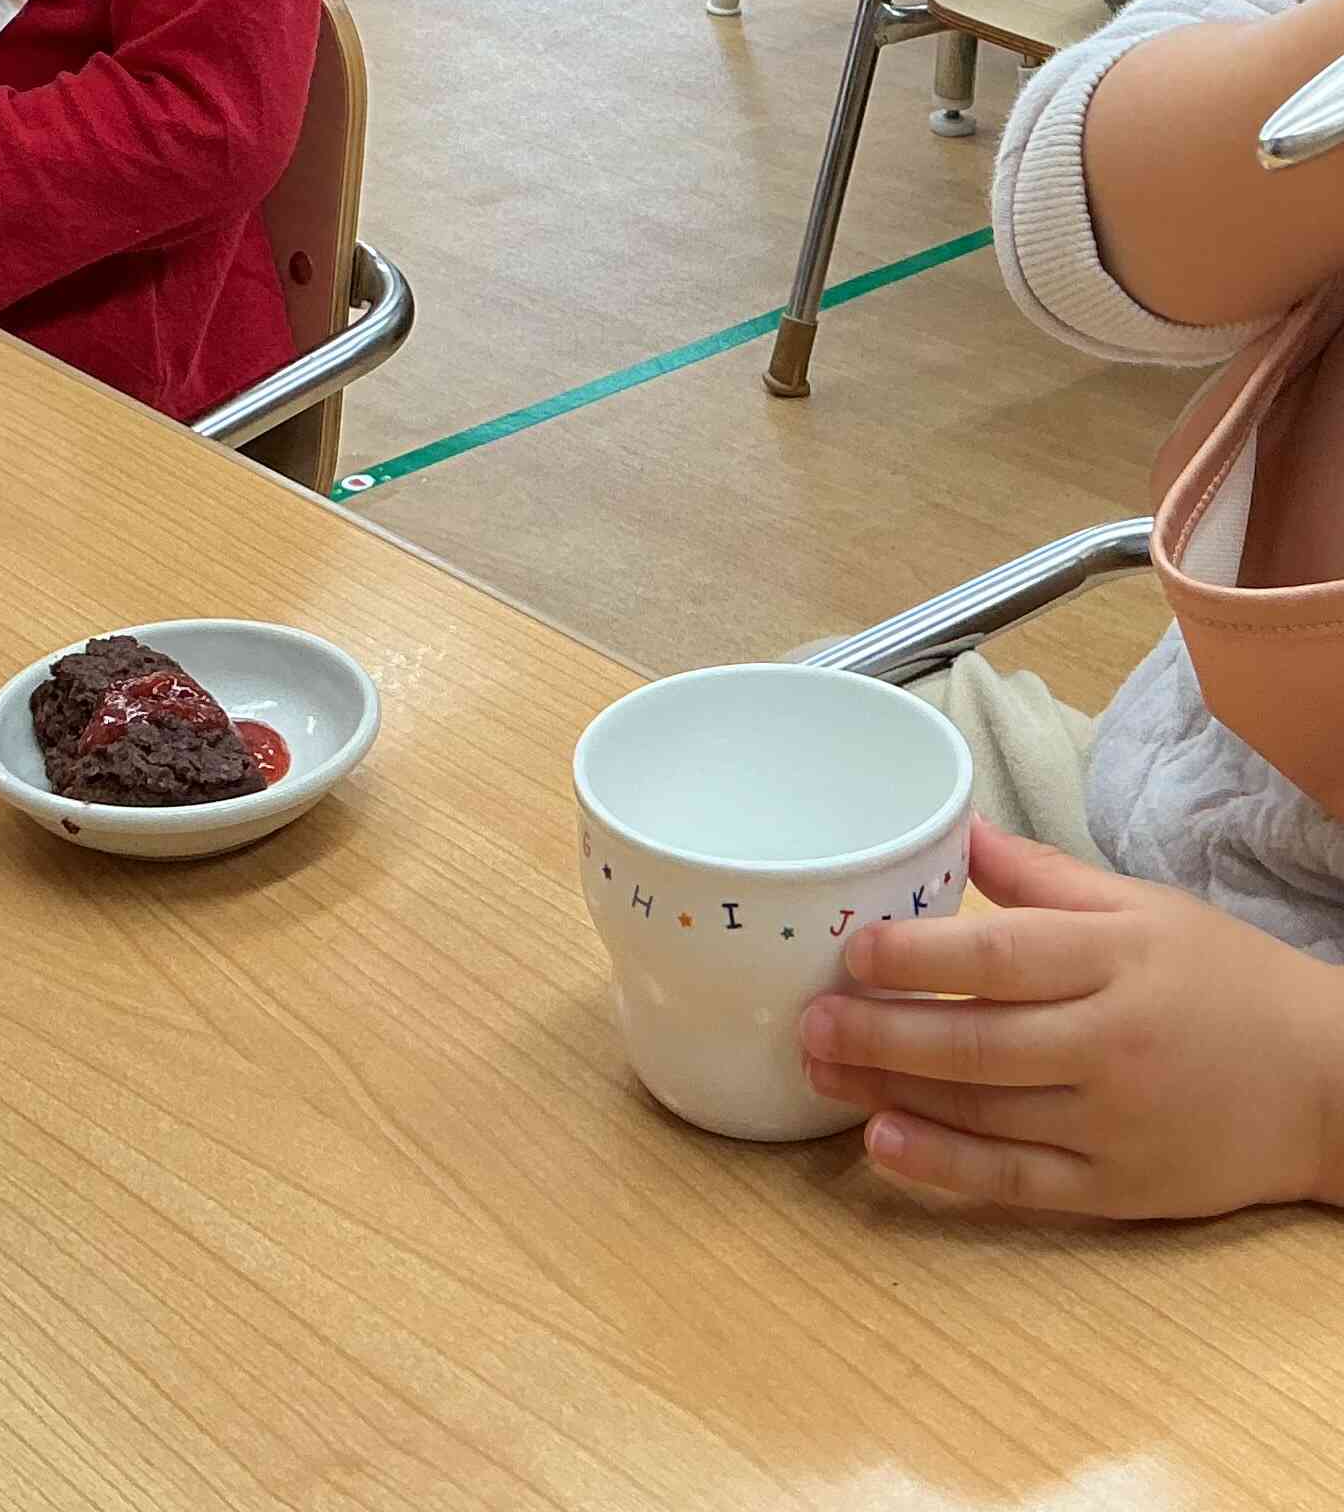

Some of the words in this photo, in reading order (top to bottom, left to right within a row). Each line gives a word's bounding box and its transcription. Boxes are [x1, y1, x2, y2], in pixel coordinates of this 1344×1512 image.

[631, 885, 653, 918] H
[721, 903, 743, 930] I
[829, 909, 854, 937] J
[912, 885, 929, 915] K
